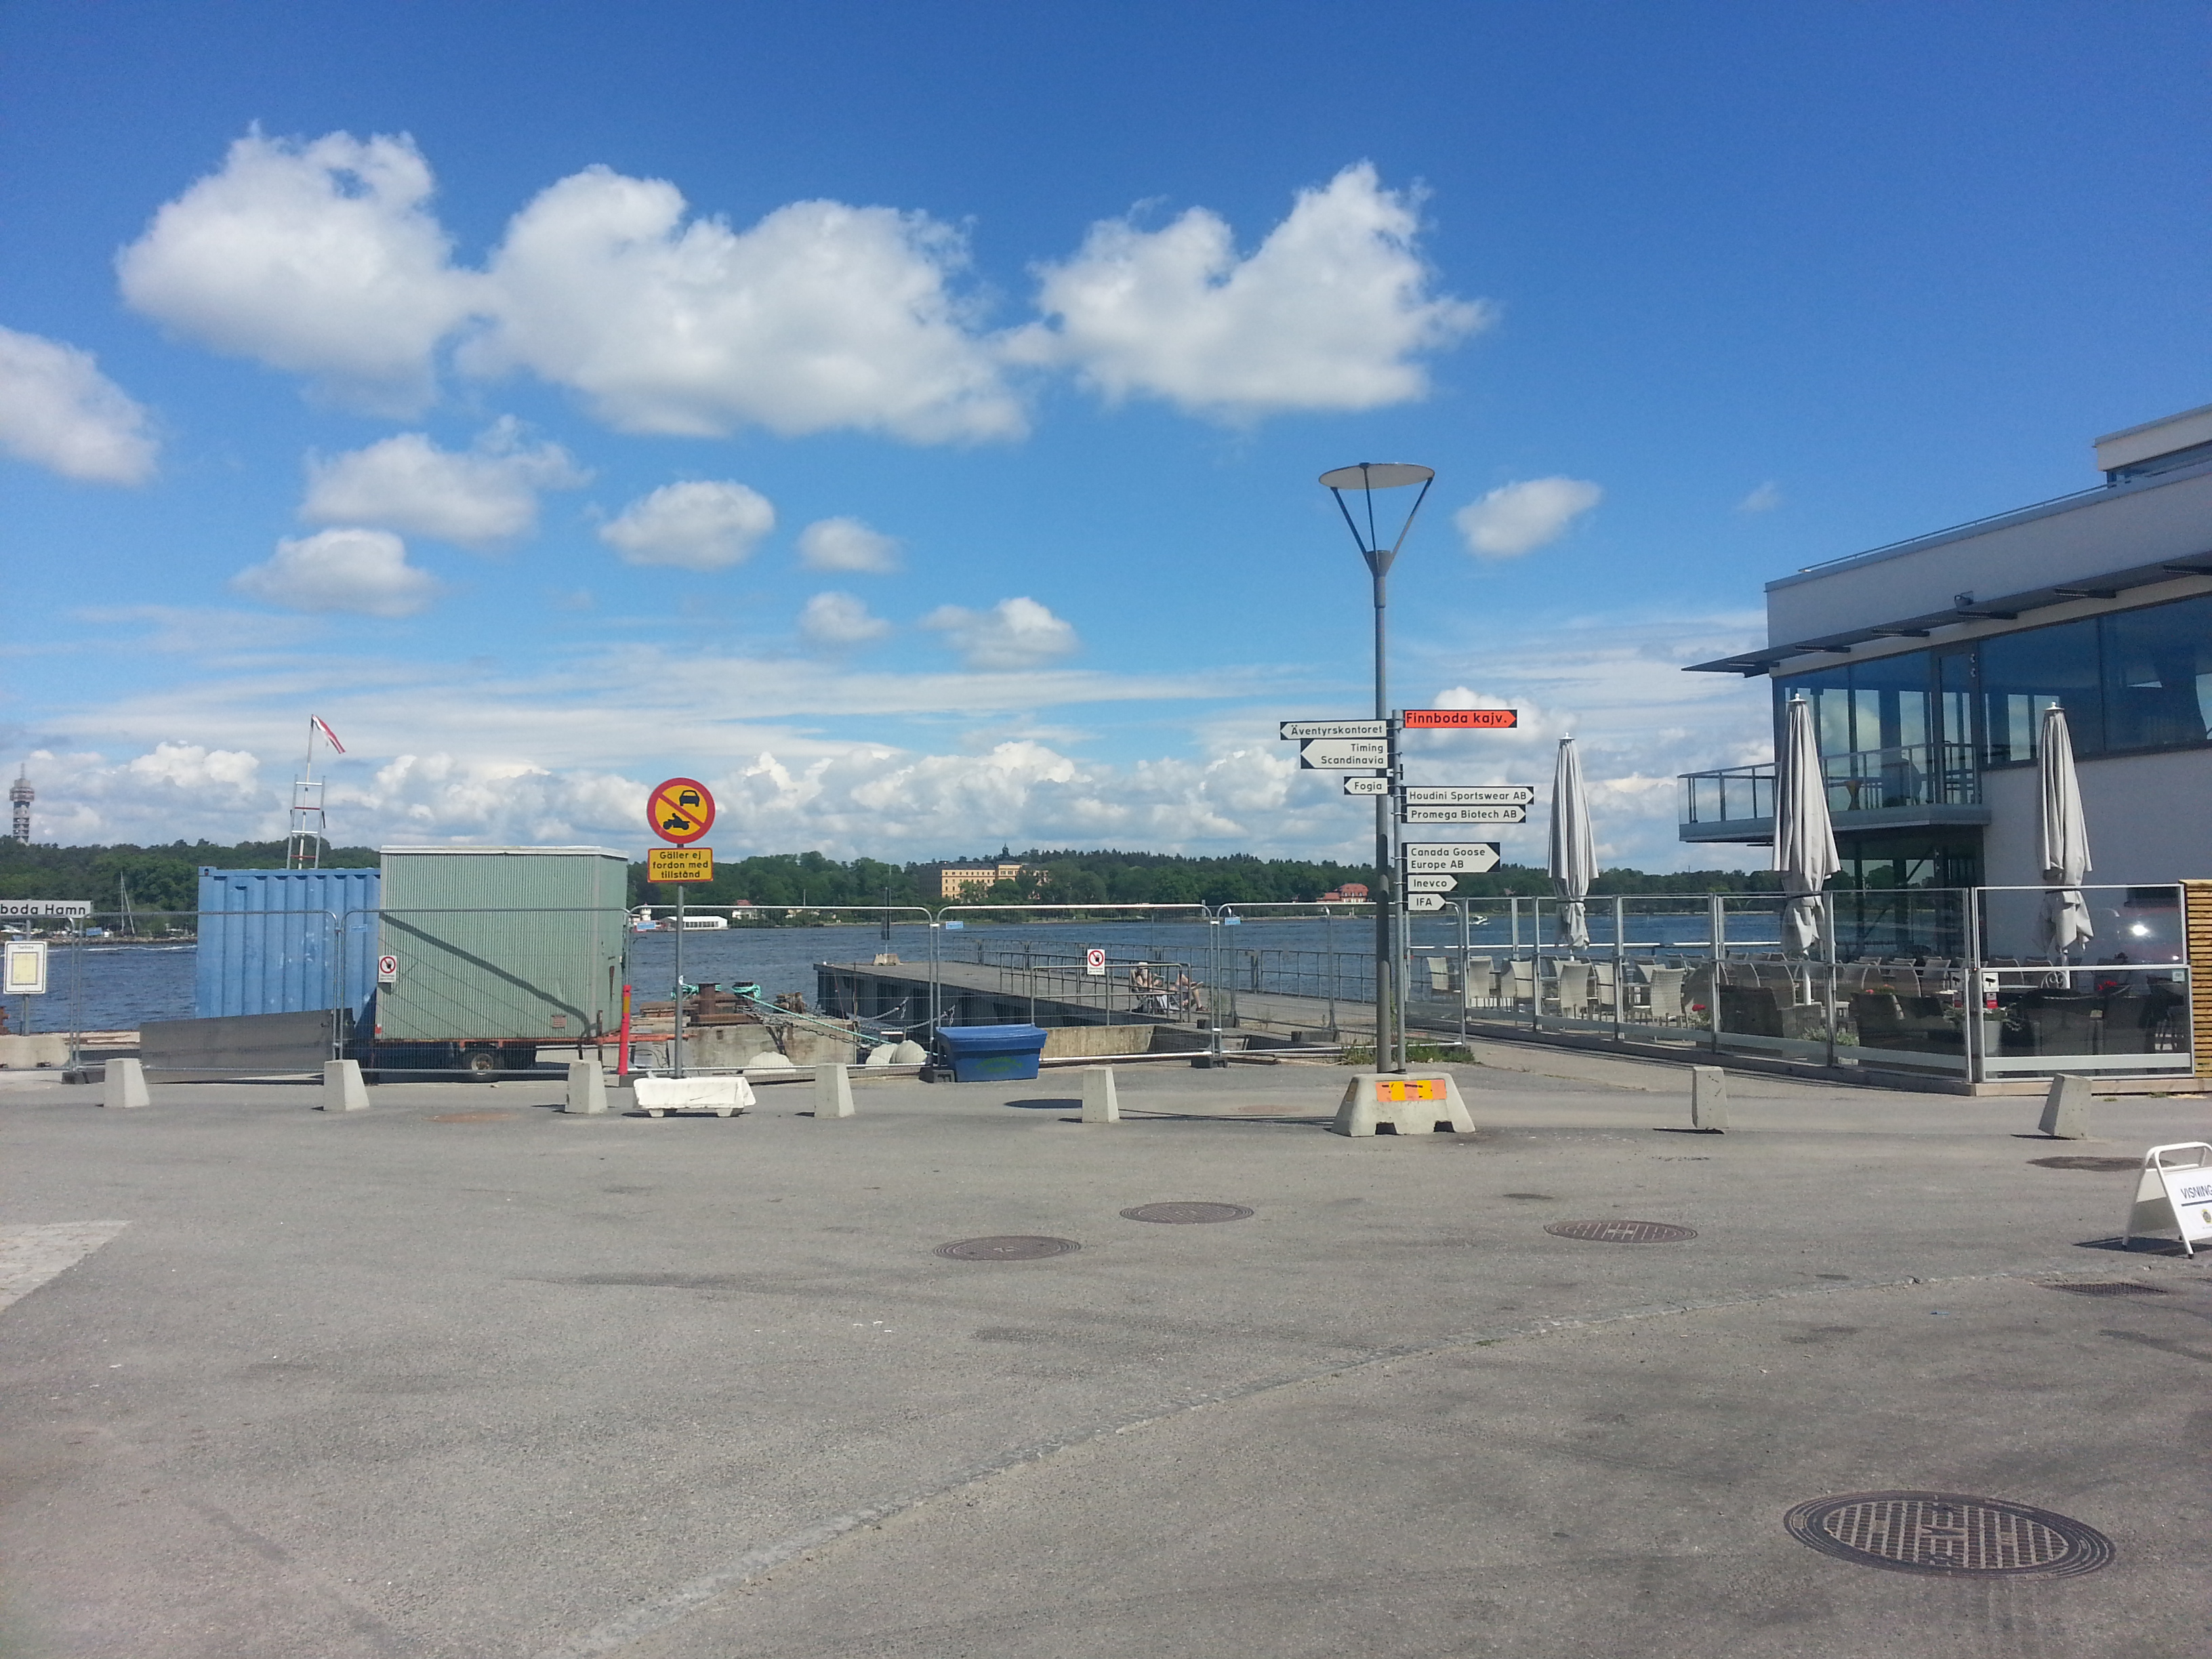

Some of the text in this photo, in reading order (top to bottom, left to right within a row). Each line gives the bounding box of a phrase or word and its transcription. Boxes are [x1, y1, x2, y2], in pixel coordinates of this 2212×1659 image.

[1406, 712, 1508, 725] Finnboda kajv.
[1290, 724, 1382, 737] Äventyrskontoret
[1351, 743, 1384, 754] Timing
[1321, 755, 1384, 764] Scandinavia
[1354, 781, 1382, 792] Fogia
[1410, 791, 1527, 802] Houdini Sportswear AB
[1411, 809, 1517, 820] Promega Biotech AB
[693, 851, 701, 860] ej
[1411, 848, 1486, 857] Canada Goose
[1411, 860, 1464, 871] Europe AB
[661, 870, 700, 878] tillstånd
[1414, 879, 1448, 888] Inevco
[1416, 898, 1433, 907] IFA
[45, 904, 86, 915] Hamn
